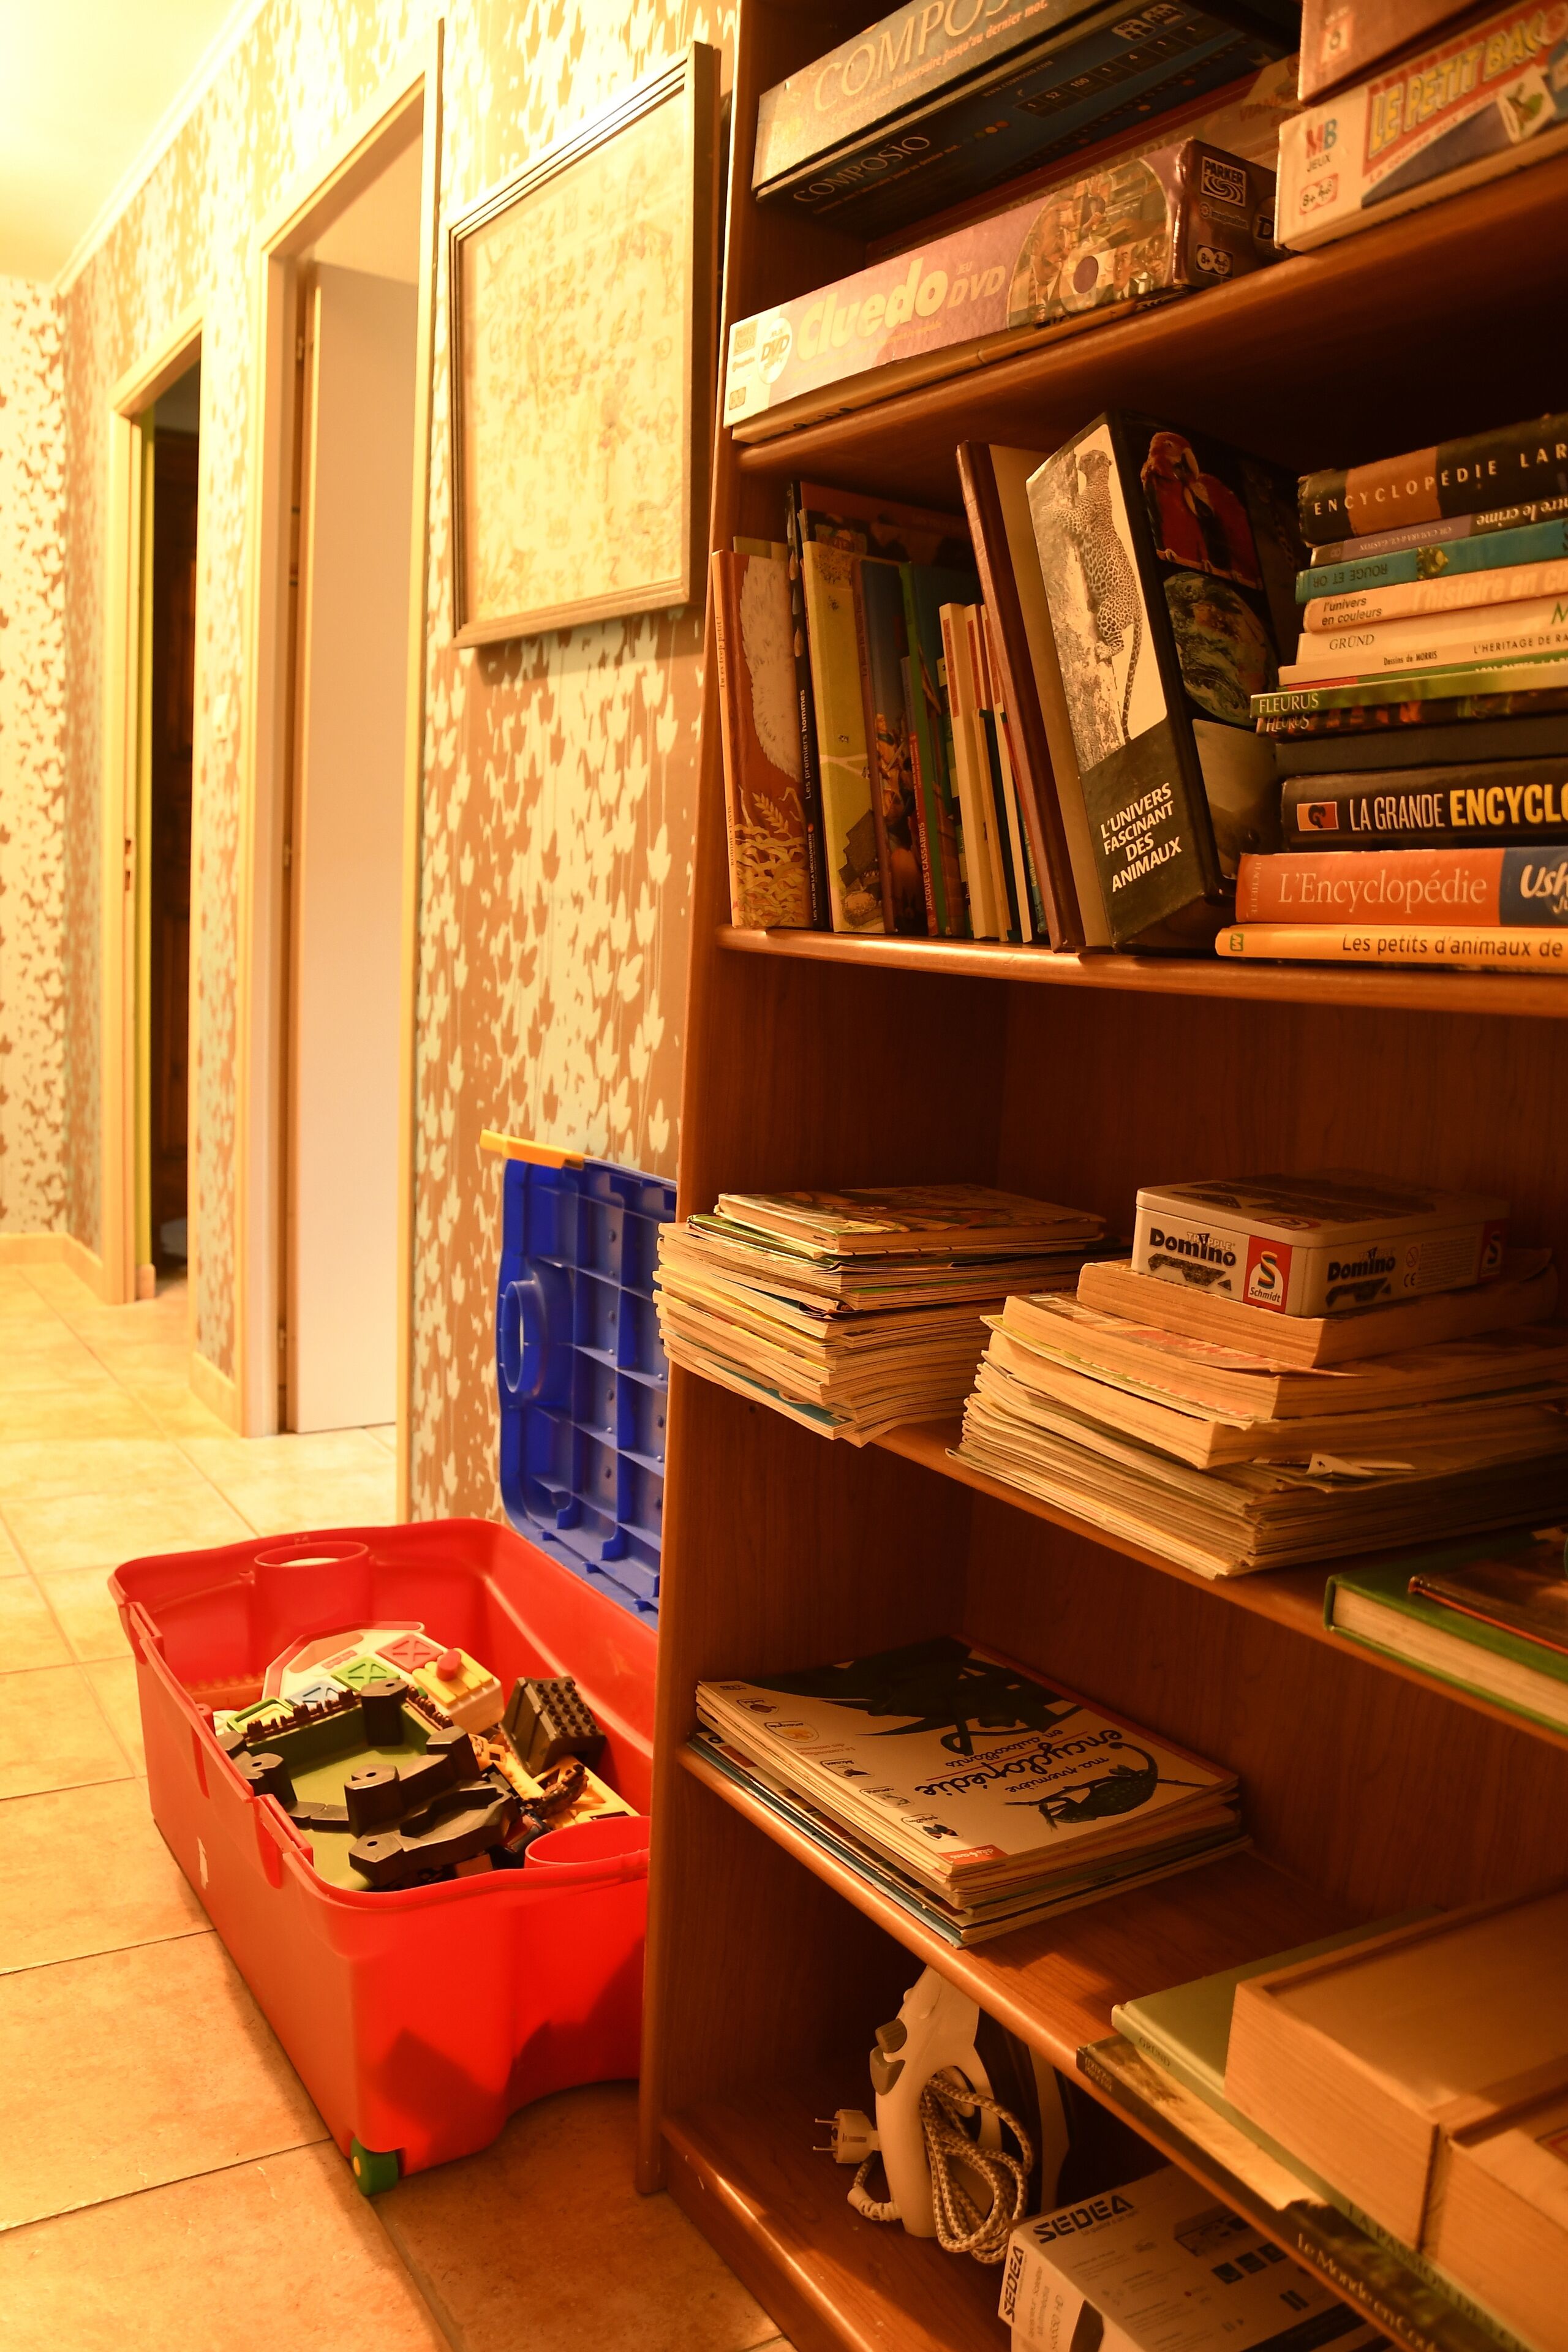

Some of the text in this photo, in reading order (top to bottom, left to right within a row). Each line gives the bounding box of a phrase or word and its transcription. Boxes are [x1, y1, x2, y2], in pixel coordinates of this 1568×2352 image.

[985, 10, 1023, 39] dernier
[1046, 90, 1060, 100] 52
[1070, 77, 1090, 87] 100
[1368, 82, 1404, 160] LE
[1403, 40, 1485, 133] PETIT
[1305, 118, 1338, 159] MB
[1205, 160, 1243, 184] PARKER
[1306, 154, 1332, 173] JEUX
[1200, 252, 1211, 265] 8+
[948, 264, 1007, 306] DVD
[796, 257, 949, 361] Cluedo
[760, 334, 791, 363] DVD
[1520, 443, 1567, 469] LAR
[1476, 508, 1520, 527] crime
[1313, 562, 1389, 589] ROUGE ET OR
[1510, 571, 1538, 597] en
[1322, 606, 1382, 626] en couleurs
[1323, 597, 1367, 612] l'univers
[1329, 633, 1375, 650] GRÜND
[1537, 635, 1551, 646] DE
[1383, 655, 1404, 666] Dessins
[1415, 650, 1438, 661] MORRIS
[799, 688, 808, 733] hommes
[1259, 692, 1319, 714] FLEURUS
[801, 734, 812, 778] premiers
[1100, 782, 1172, 839] L'UNIVERS
[1349, 797, 1373, 832] LA
[1373, 793, 1446, 831] GRANDE
[1103, 800, 1174, 856] FASCINANT
[1125, 832, 1155, 862] DES
[919, 821, 933, 910] JACQUES CASSABOIS
[1112, 836, 1183, 892] ANIMAUX
[1251, 861, 1263, 917] HACHETTE
[1278, 868, 1488, 914] L'Encyclopédie
[1342, 933, 1564, 958] Les petits d'animaux de
[1149, 1227, 1237, 1267] Domino
[1327, 1256, 1396, 1282] Domino
[1249, 1286, 1281, 1303] Schmidt
[945, 1728, 1064, 1768] en autocollants
[914, 1730, 1123, 1796] encyclopédie
[1005, 1757, 1110, 1793] ma première
[1033, 2195, 1135, 2244] SEDEA
[1003, 2245, 1024, 2324] SEDEA
